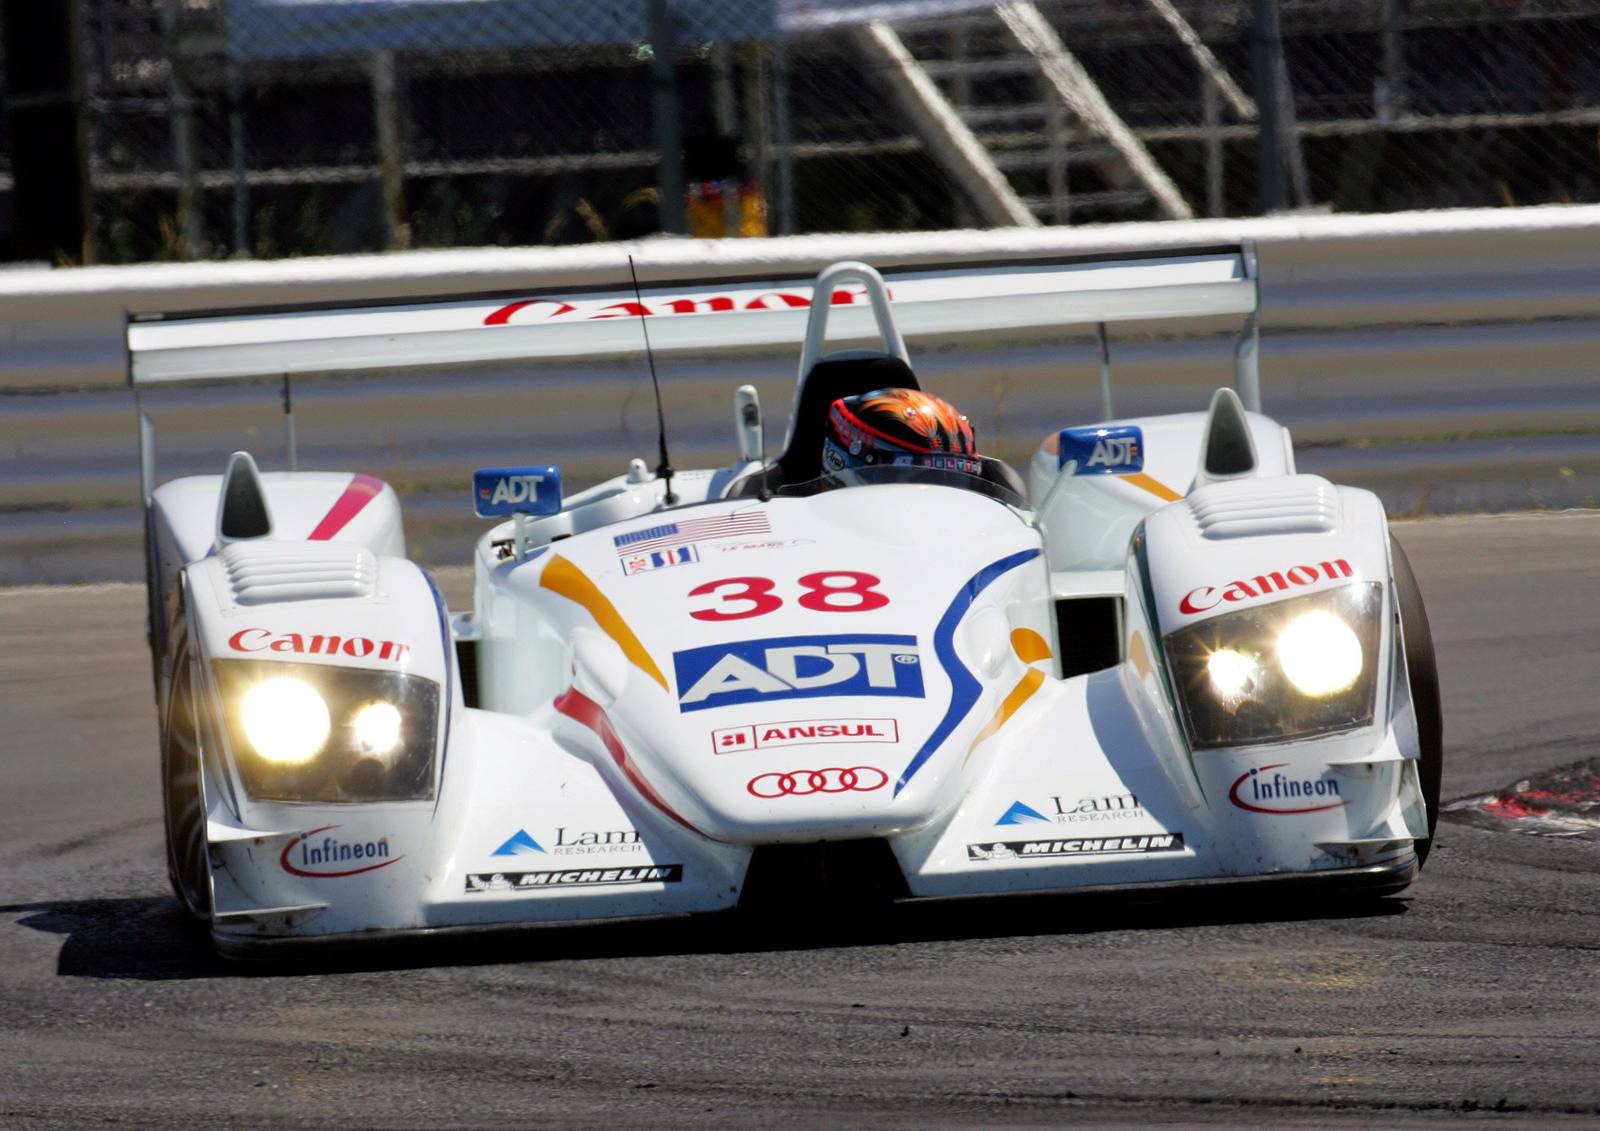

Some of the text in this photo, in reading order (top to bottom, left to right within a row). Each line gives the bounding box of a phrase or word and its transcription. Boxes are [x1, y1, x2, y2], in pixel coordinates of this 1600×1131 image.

[1086, 437, 1137, 467] ADT
[491, 475, 545, 505] ADT
[687, 570, 890, 622] 38
[1179, 558, 1354, 615] Canon
[228, 627, 411, 663] Canon
[762, 724, 885, 742] ANSUL
[1053, 793, 1141, 816] Lam
[1056, 810, 1145, 825] RESEARCH
[554, 826, 642, 848] Lam
[1022, 833, 1175, 856] MICHELIN
[553, 844, 643, 857] RESEARCH
[519, 866, 673, 887] MICHELIN
